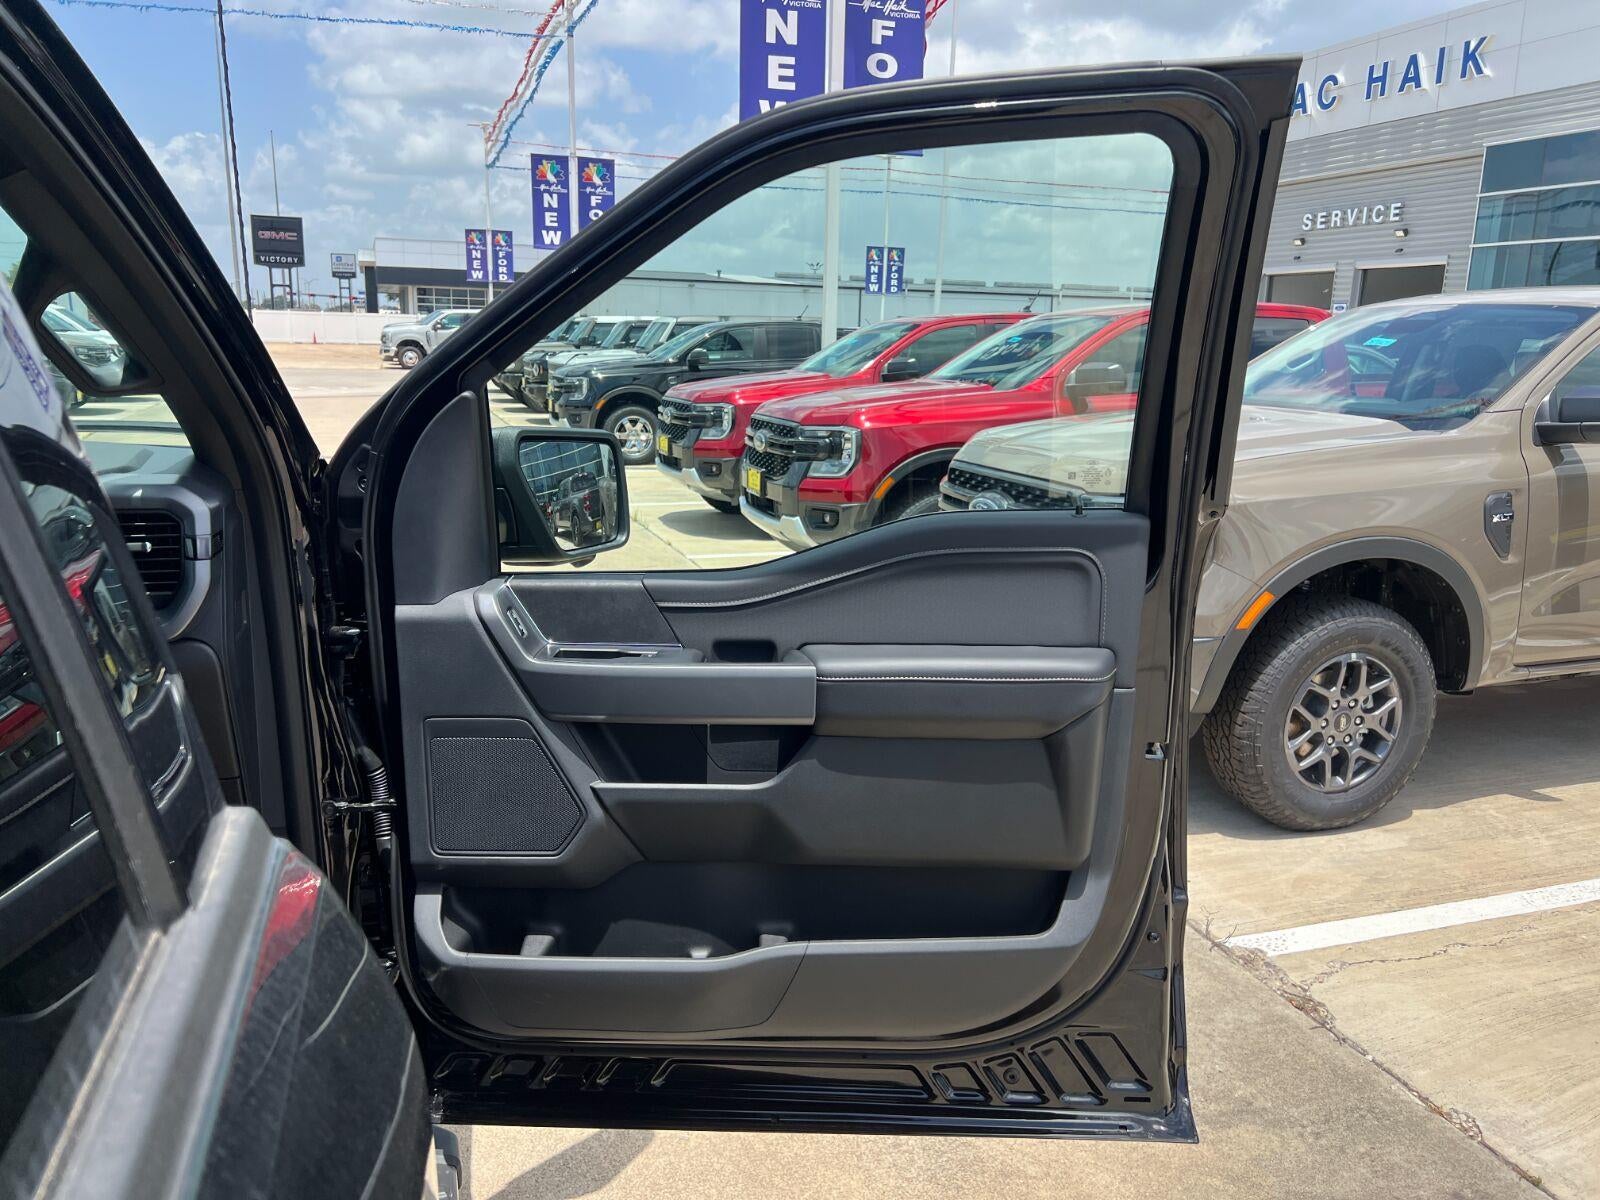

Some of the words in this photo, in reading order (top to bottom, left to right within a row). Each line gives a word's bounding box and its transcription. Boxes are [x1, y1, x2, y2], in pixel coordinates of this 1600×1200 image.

[788, 0, 822, 9] VICTORIA
[889, 11, 921, 19] VICTORIA
[866, 18, 898, 79] FO
[1291, 73, 1341, 116] AC
[1364, 35, 1489, 101] HAIK
[541, 192, 562, 245] NEW
[588, 195, 604, 221] FO
[1302, 202, 1404, 231] SERVICE
[258, 230, 298, 240] GMC
[260, 255, 299, 264] VICTORY
[471, 249, 484, 279] NEW
[497, 251, 508, 281] FORD
[869, 265, 879, 292] NEW
[891, 265, 899, 293] FORD
